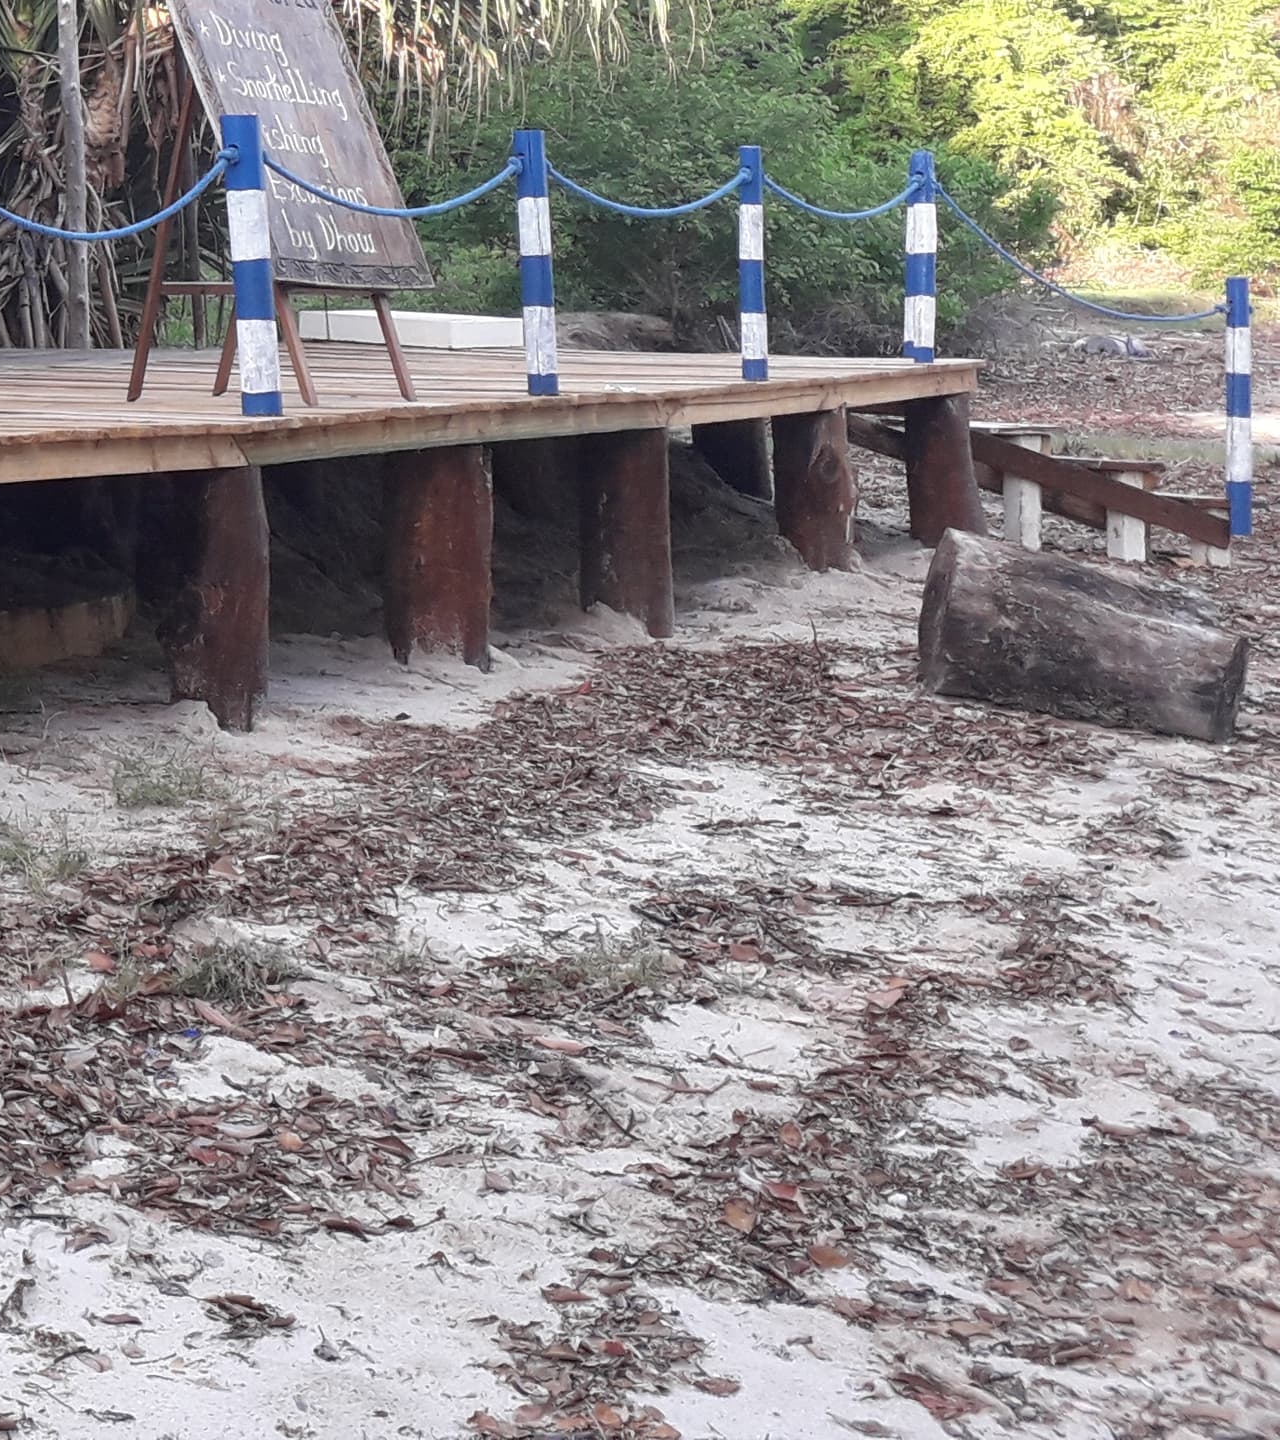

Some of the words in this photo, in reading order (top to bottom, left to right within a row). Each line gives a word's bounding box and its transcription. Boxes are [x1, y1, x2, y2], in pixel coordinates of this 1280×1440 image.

[209, 10, 289, 67] Diving
[262, 114, 330, 168] ishing
[263, 163, 369, 207] Excusions
[281, 207, 319, 261] by
[316, 211, 378, 255] Dhow
